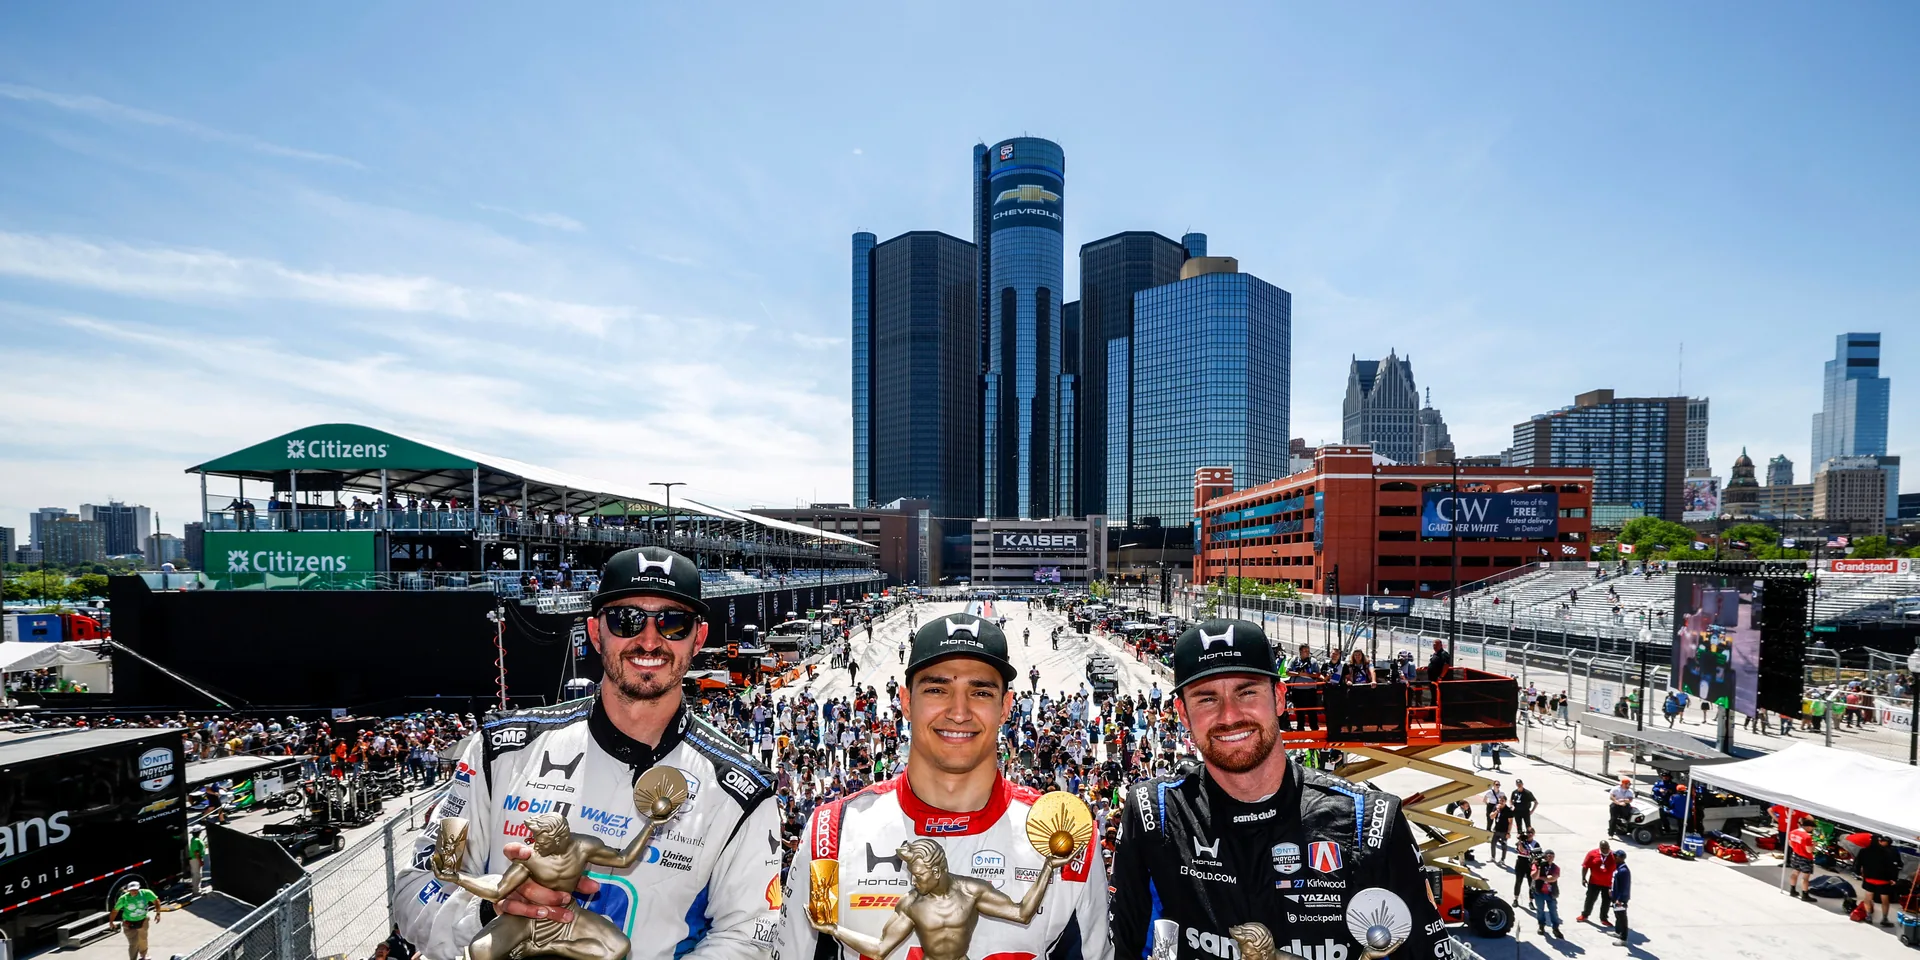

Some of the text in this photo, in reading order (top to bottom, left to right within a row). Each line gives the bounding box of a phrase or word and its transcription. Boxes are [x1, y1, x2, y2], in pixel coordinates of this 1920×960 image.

[308, 440, 387, 458] Citizens
[1436, 497, 1492, 522] GW
[1513, 507, 1537, 516] FREE
[1528, 517, 1553, 526] delivery
[1471, 524, 1499, 533] WHITE
[1002, 535, 1077, 546] KAISER
[253, 551, 346, 571] Citizens
[1835, 561, 1894, 571] Grandstand
[1900, 561, 1908, 571] 9
[631, 576, 676, 587] Honda
[939, 639, 984, 649] Honda
[1198, 650, 1242, 662] Honda
[491, 731, 527, 747] OMP
[152, 754, 169, 763] NTT
[140, 763, 174, 777] INDYCAR
[525, 781, 575, 793] Honda
[725, 771, 756, 796] OMP
[503, 795, 552, 813] Mobil
[1137, 786, 1156, 831] sparco
[1258, 808, 1277, 820] club
[925, 816, 970, 832] HRC
[1367, 799, 1387, 848] sparco
[592, 824, 627, 838] GROUP
[818, 809, 832, 857] sparco
[666, 829, 706, 848] Edwards
[662, 850, 693, 864] United
[984, 857, 1001, 865] NTT
[1191, 859, 1223, 867] Honda
[660, 858, 692, 872] Rentals
[970, 867, 1005, 875] INDYCAR
[857, 878, 908, 887] Honda
[1293, 878, 1346, 889] 27 Kirkwood
[1299, 913, 1342, 924] blackpoint
